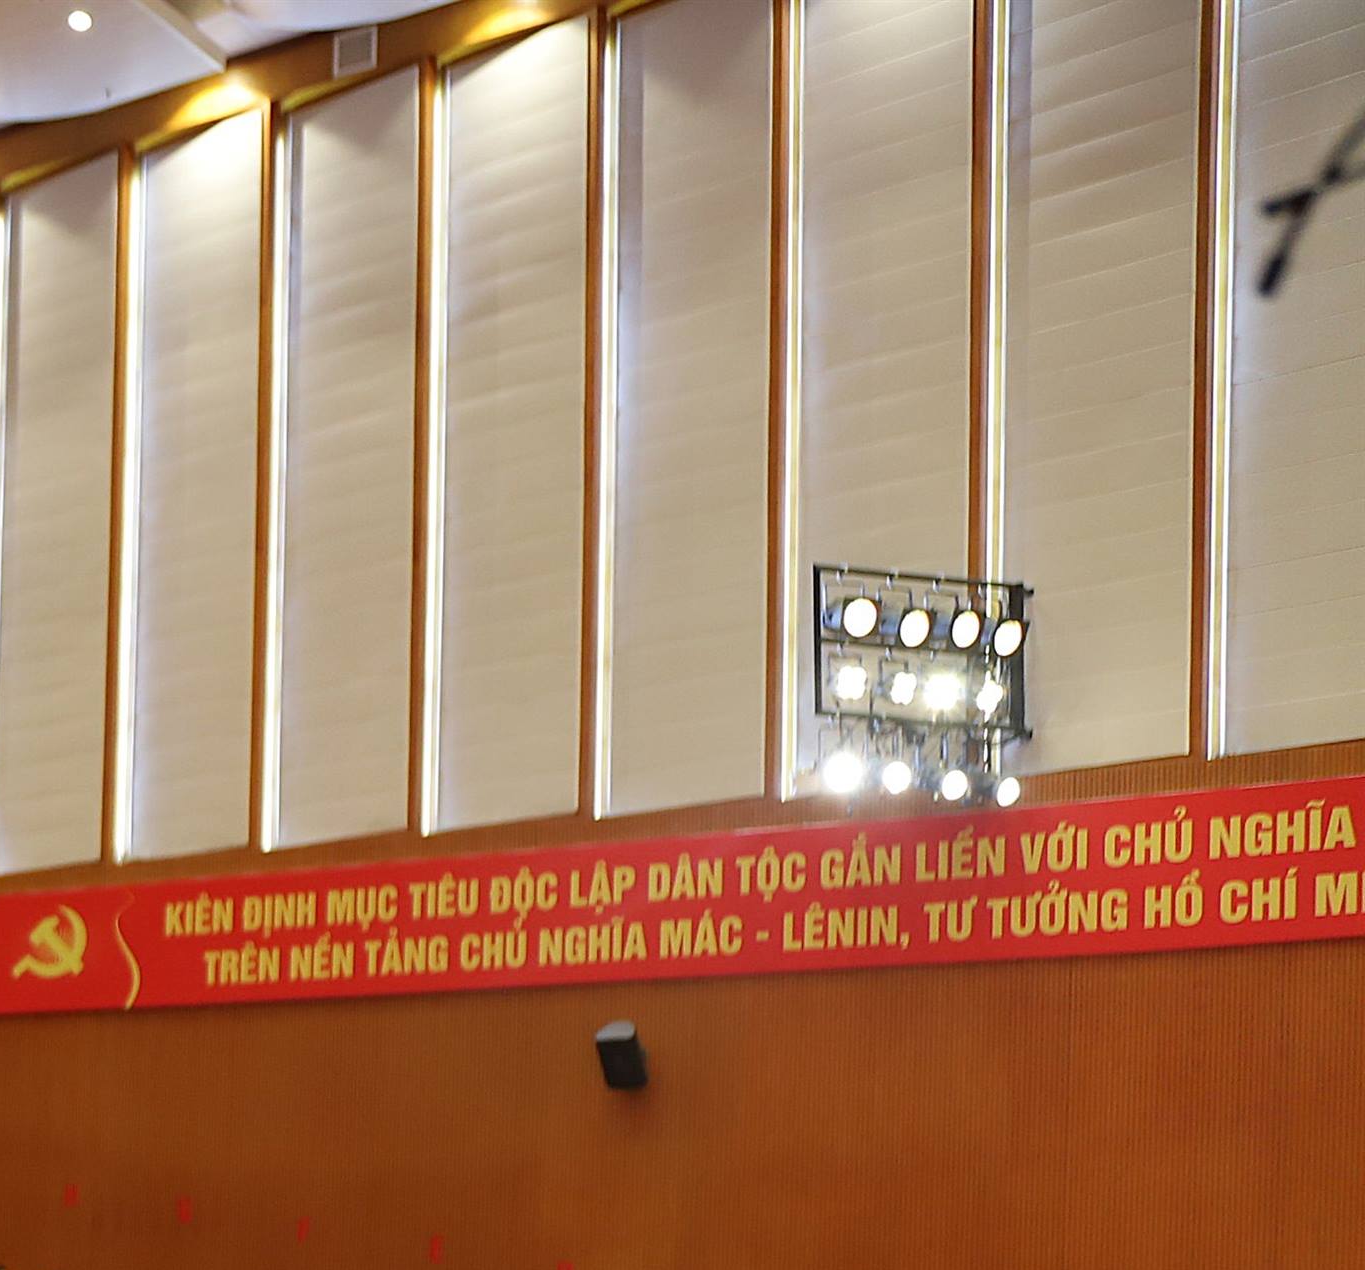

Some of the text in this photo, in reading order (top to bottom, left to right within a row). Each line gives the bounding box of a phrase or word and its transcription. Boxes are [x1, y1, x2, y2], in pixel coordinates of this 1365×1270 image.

[165, 798, 1357, 939] KIÊN ĐỊNH MỤC TIÊU ĐỘC LẬP DÂN TỘC GẮN LIỀN VỚI CHỦ NGHĨA
[204, 940, 280, 987] TRÊN
[289, 931, 355, 982] NỀN
[364, 926, 449, 978] TẢNG
[460, 916, 528, 972] CHỦ
[538, 915, 647, 968] NGHĨA
[659, 908, 743, 960] MÁC
[782, 902, 910, 954] LÊNIN,
[923, 895, 978, 944] TƯ
[986, 879, 1129, 938] TƯỞNG
[1144, 868, 1204, 930] HỒ
[1219, 866, 1298, 925] CHÍ
